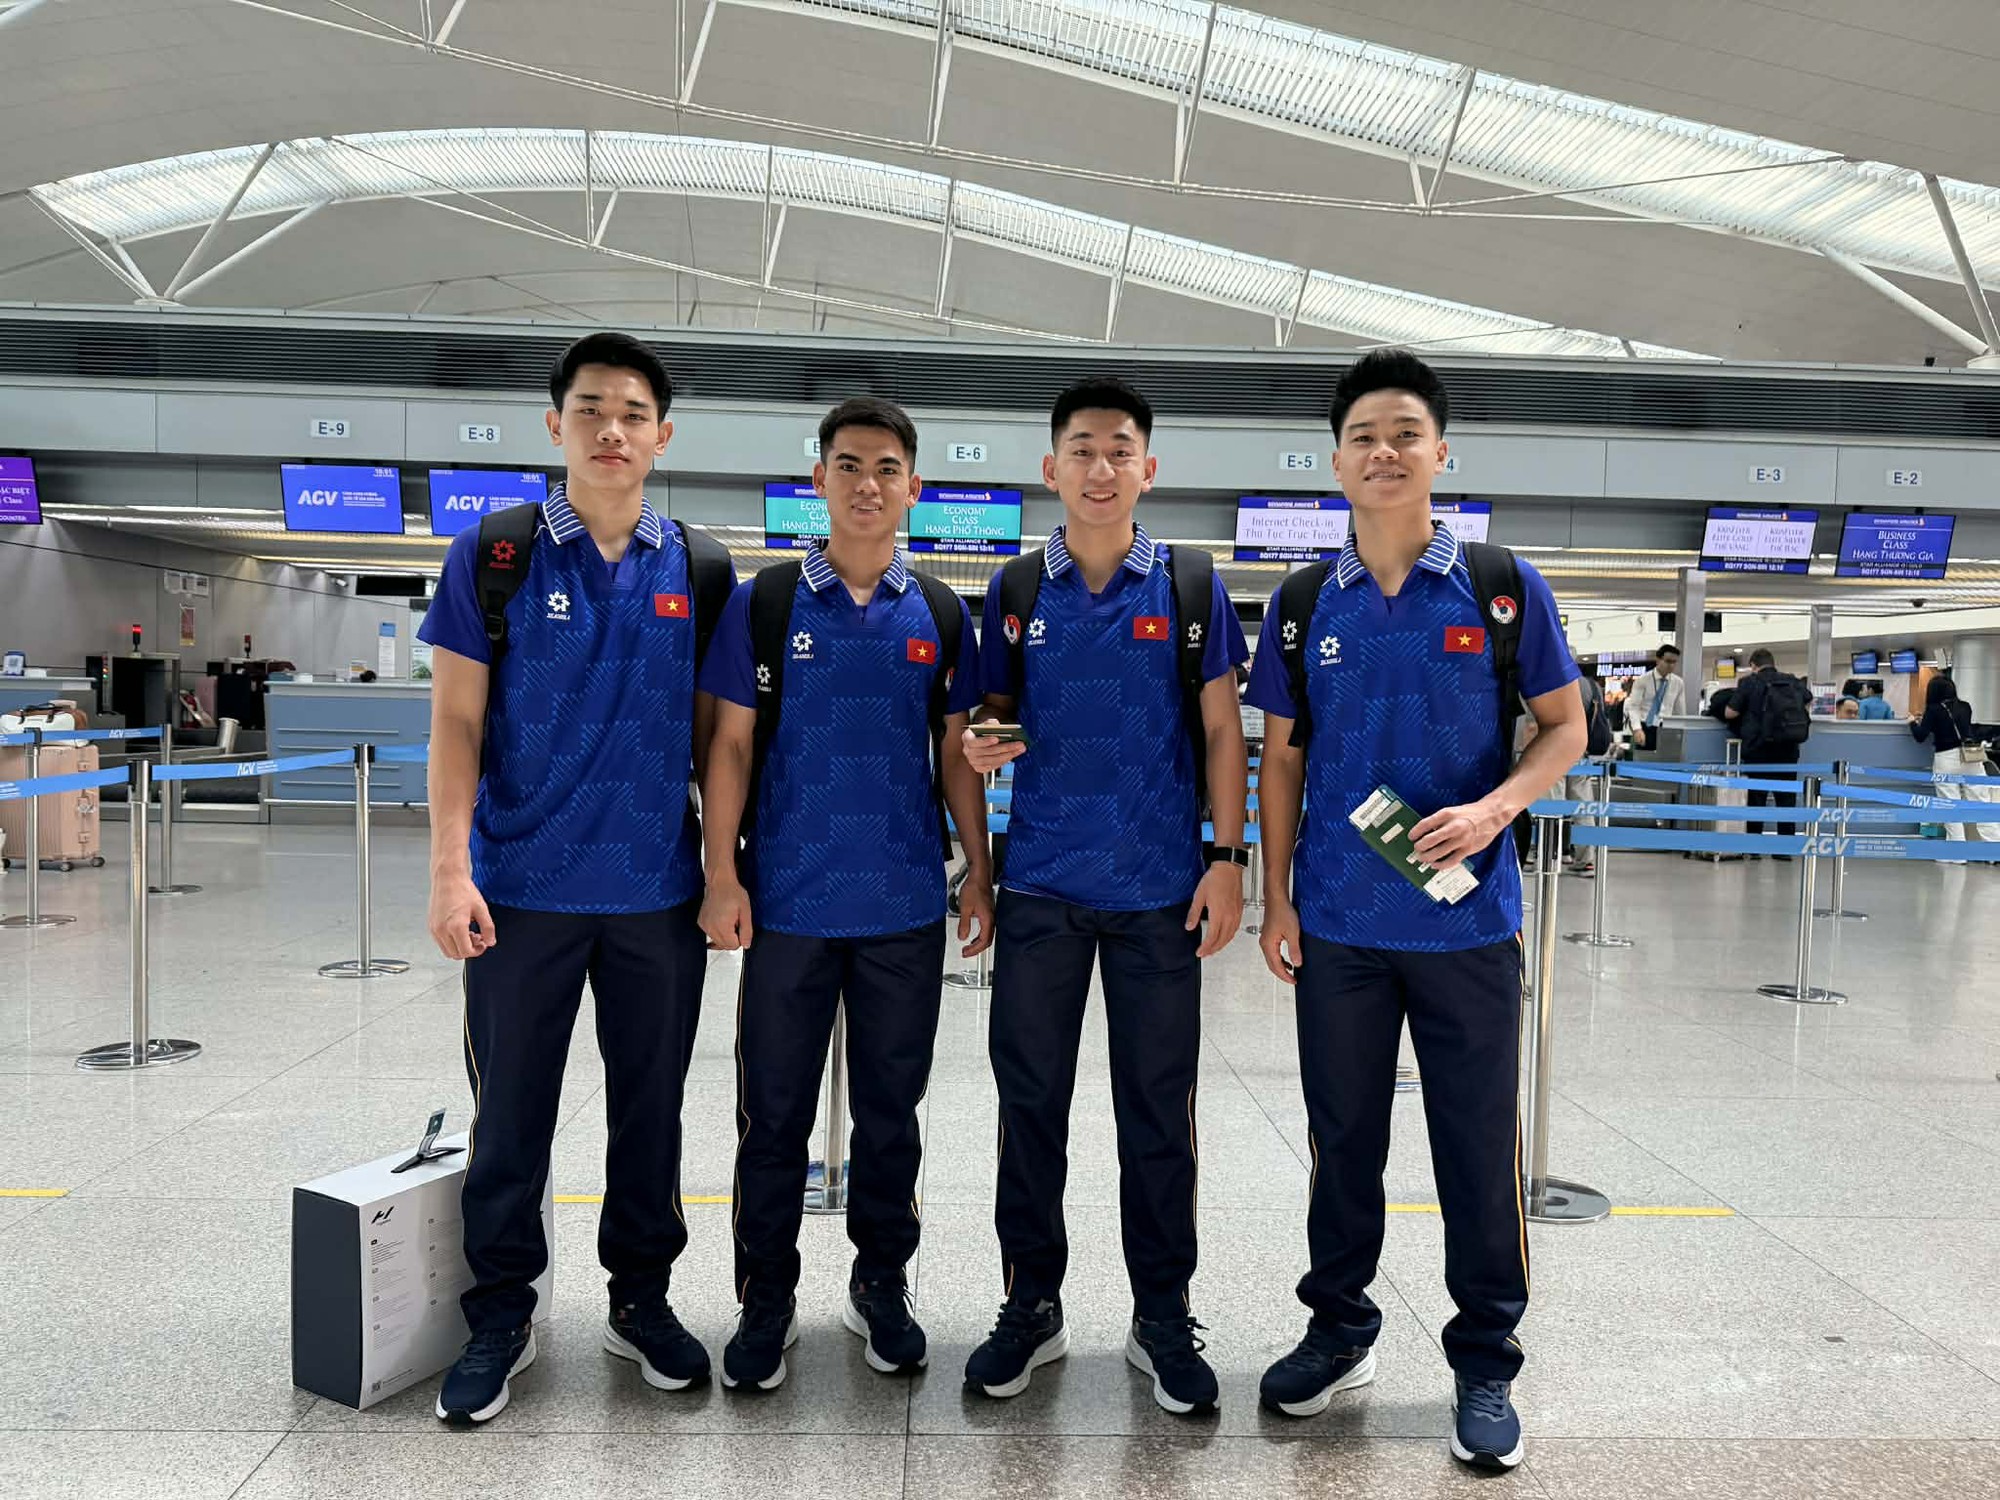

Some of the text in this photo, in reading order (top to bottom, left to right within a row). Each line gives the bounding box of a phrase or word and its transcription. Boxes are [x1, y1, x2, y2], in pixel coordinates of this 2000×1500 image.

[318, 421, 345, 436] E-9
[468, 426, 494, 441] E-8
[956, 446, 981, 460] E-6
[1287, 455, 1312, 468] E-5
[1756, 468, 1781, 482] E-3
[1893, 472, 1918, 485] E-2
[297, 489, 338, 506] ACV
[445, 495, 485, 511] ACV
[800, 501, 828, 510] ECON
[943, 506, 987, 515] ECONOMY
[809, 511, 830, 520] CLA
[952, 515, 979, 525] CLASS
[1252, 516, 1334, 528] Internet Check-in
[1878, 530, 1916, 540] BUSINESS
[1883, 540, 1909, 549] CLASS
[236, 762, 257, 776] ACV
[1690, 774, 1708, 784] ACV
[1930, 773, 1947, 782] ACV
[1909, 795, 1931, 808] ACV
[1573, 802, 1609, 815] ACV
[1818, 808, 1853, 822] ACV
[1801, 837, 1850, 855] ACV
